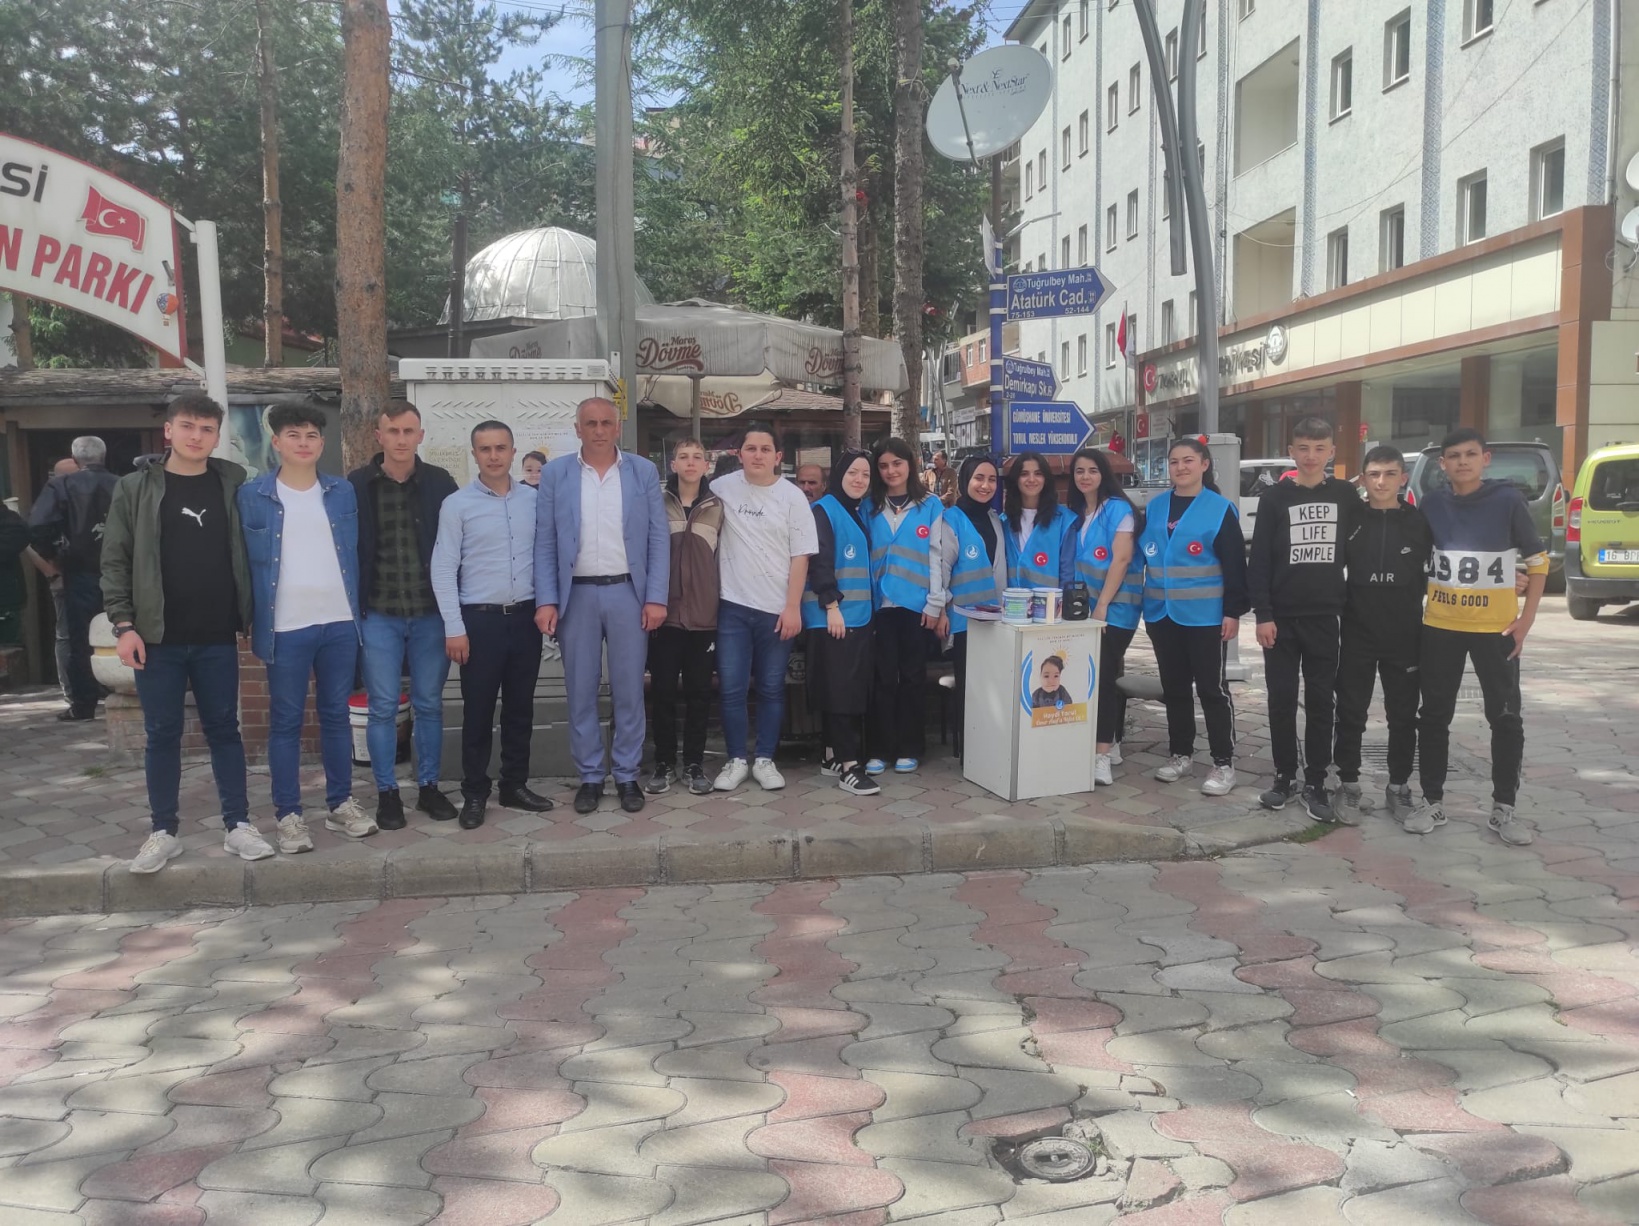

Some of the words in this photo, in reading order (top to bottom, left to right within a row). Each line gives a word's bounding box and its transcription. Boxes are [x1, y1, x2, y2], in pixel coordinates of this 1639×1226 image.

[31, 233, 154, 315] PARKI
[1027, 276, 1066, 289] Tuğrulbey
[1011, 291, 1055, 310] Atatürk
[1060, 288, 1087, 306] Cad.
[636, 337, 703, 368] Dövme
[805, 347, 844, 375] Dövm
[1004, 374, 1037, 397] Demirkapı
[1299, 505, 1330, 520] KEEP
[1303, 526, 1327, 540] LIFE
[1292, 547, 1333, 562] SIMPLE
[1370, 572, 1394, 583] AIR
[1432, 590, 1457, 606] FEELS
[1461, 594, 1489, 607] GOOD
